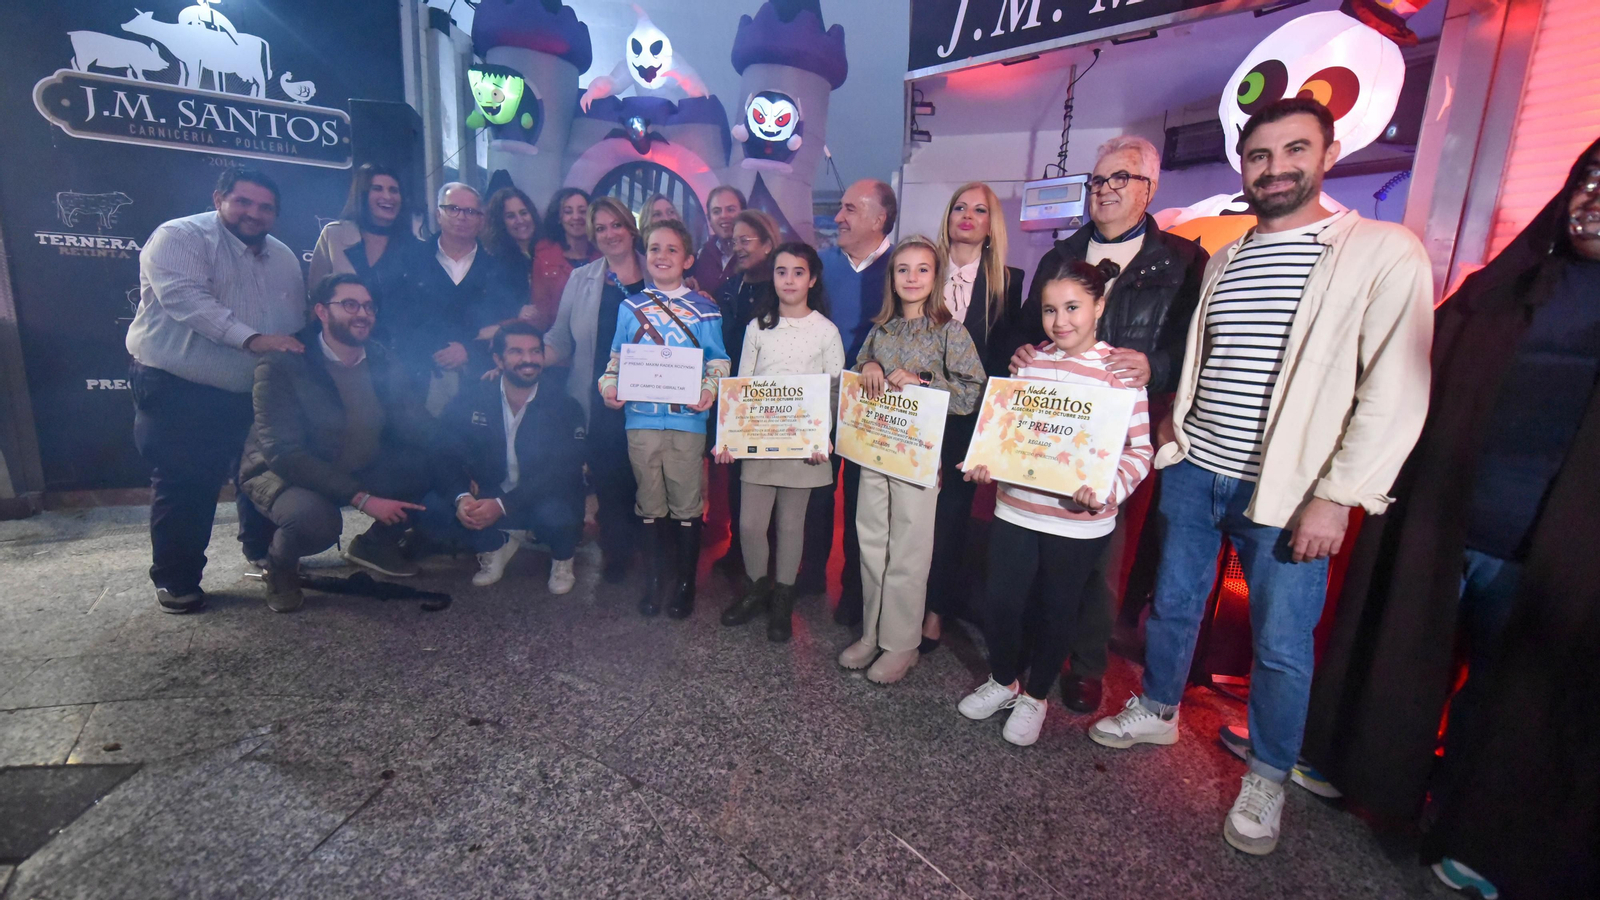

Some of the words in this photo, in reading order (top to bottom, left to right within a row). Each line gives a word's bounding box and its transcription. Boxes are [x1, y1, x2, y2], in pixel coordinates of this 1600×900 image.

[79, 85, 166, 123] J.M.
[178, 98, 339, 147] SANTOS
[129, 123, 215, 144] CARNICERÍA
[235, 137, 298, 155] POLLERÍA
[34, 233, 141, 251] TERNERA
[59, 246, 130, 259] RETINTA
[741, 385, 803, 398] Tosantos
[1027, 385, 1047, 395] Noche
[1048, 387, 1057, 396] de
[759, 405, 793, 413] PREMIO
[1013, 389, 1093, 415] Tosantos
[874, 411, 907, 427] PREMIO
[1053, 411, 1076, 419] OCTUBRE
[1028, 421, 1073, 436] PREMIO
[1027, 439, 1052, 447] REGALOS
